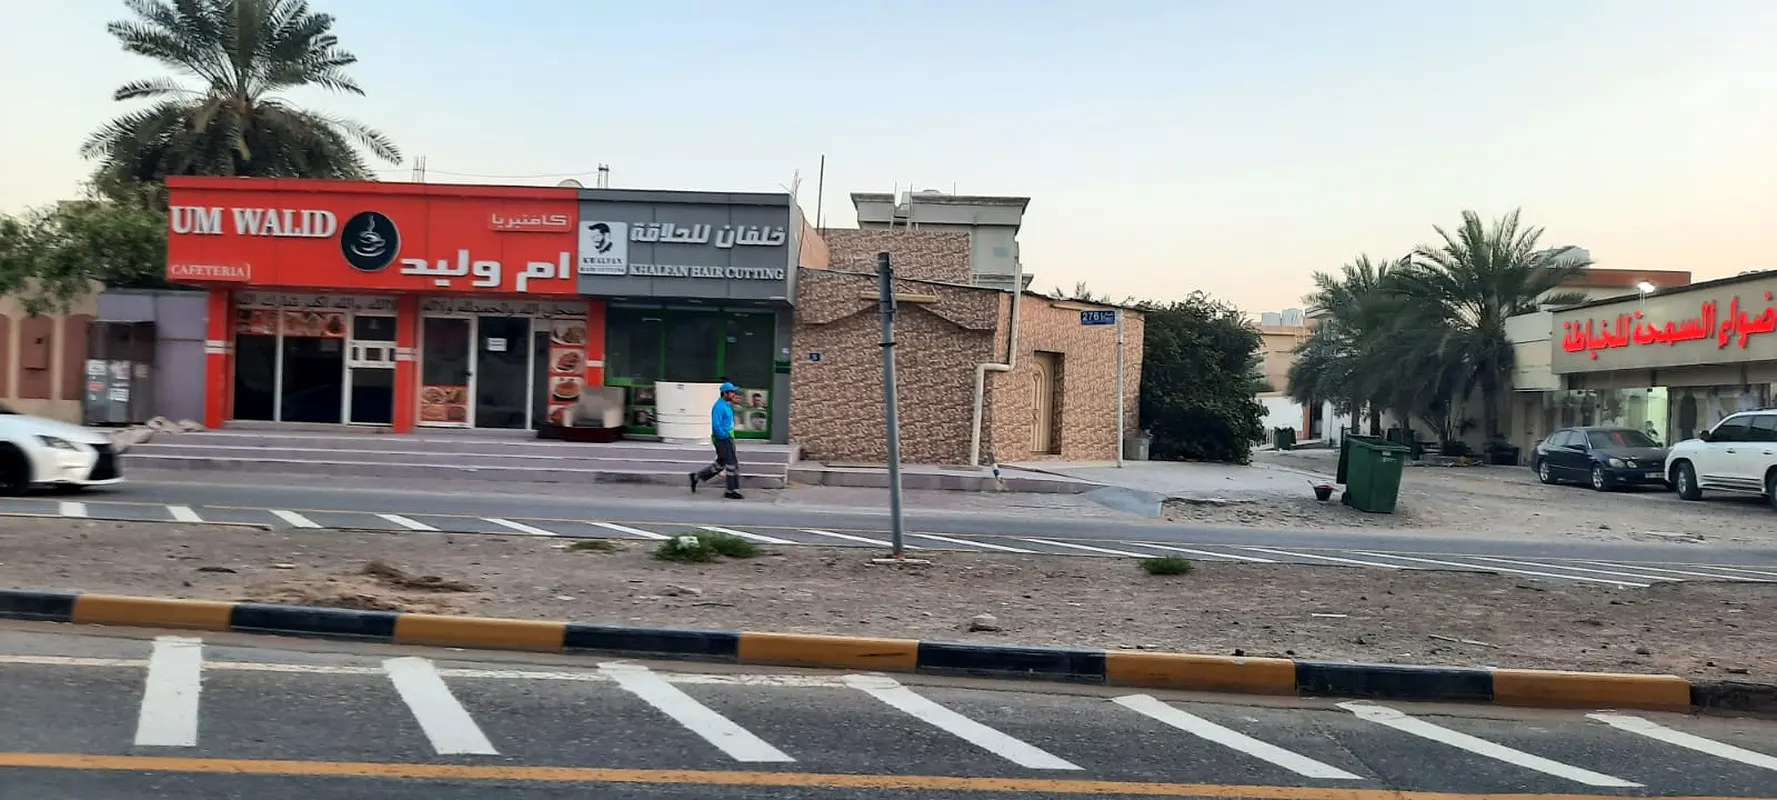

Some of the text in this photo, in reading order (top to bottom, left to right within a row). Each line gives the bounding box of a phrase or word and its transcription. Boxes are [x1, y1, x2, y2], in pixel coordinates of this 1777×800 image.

[169, 205, 337, 238] UM WALID
[491, 212, 568, 229] كافتيريا
[630, 222, 786, 249] خلفان للحلاقة
[171, 263, 245, 278] CAFETERIA
[399, 248, 502, 288] وليد
[629, 263, 786, 281] KHALFAN HAIR CUTTING
[1632, 301, 1717, 347] السمحة
